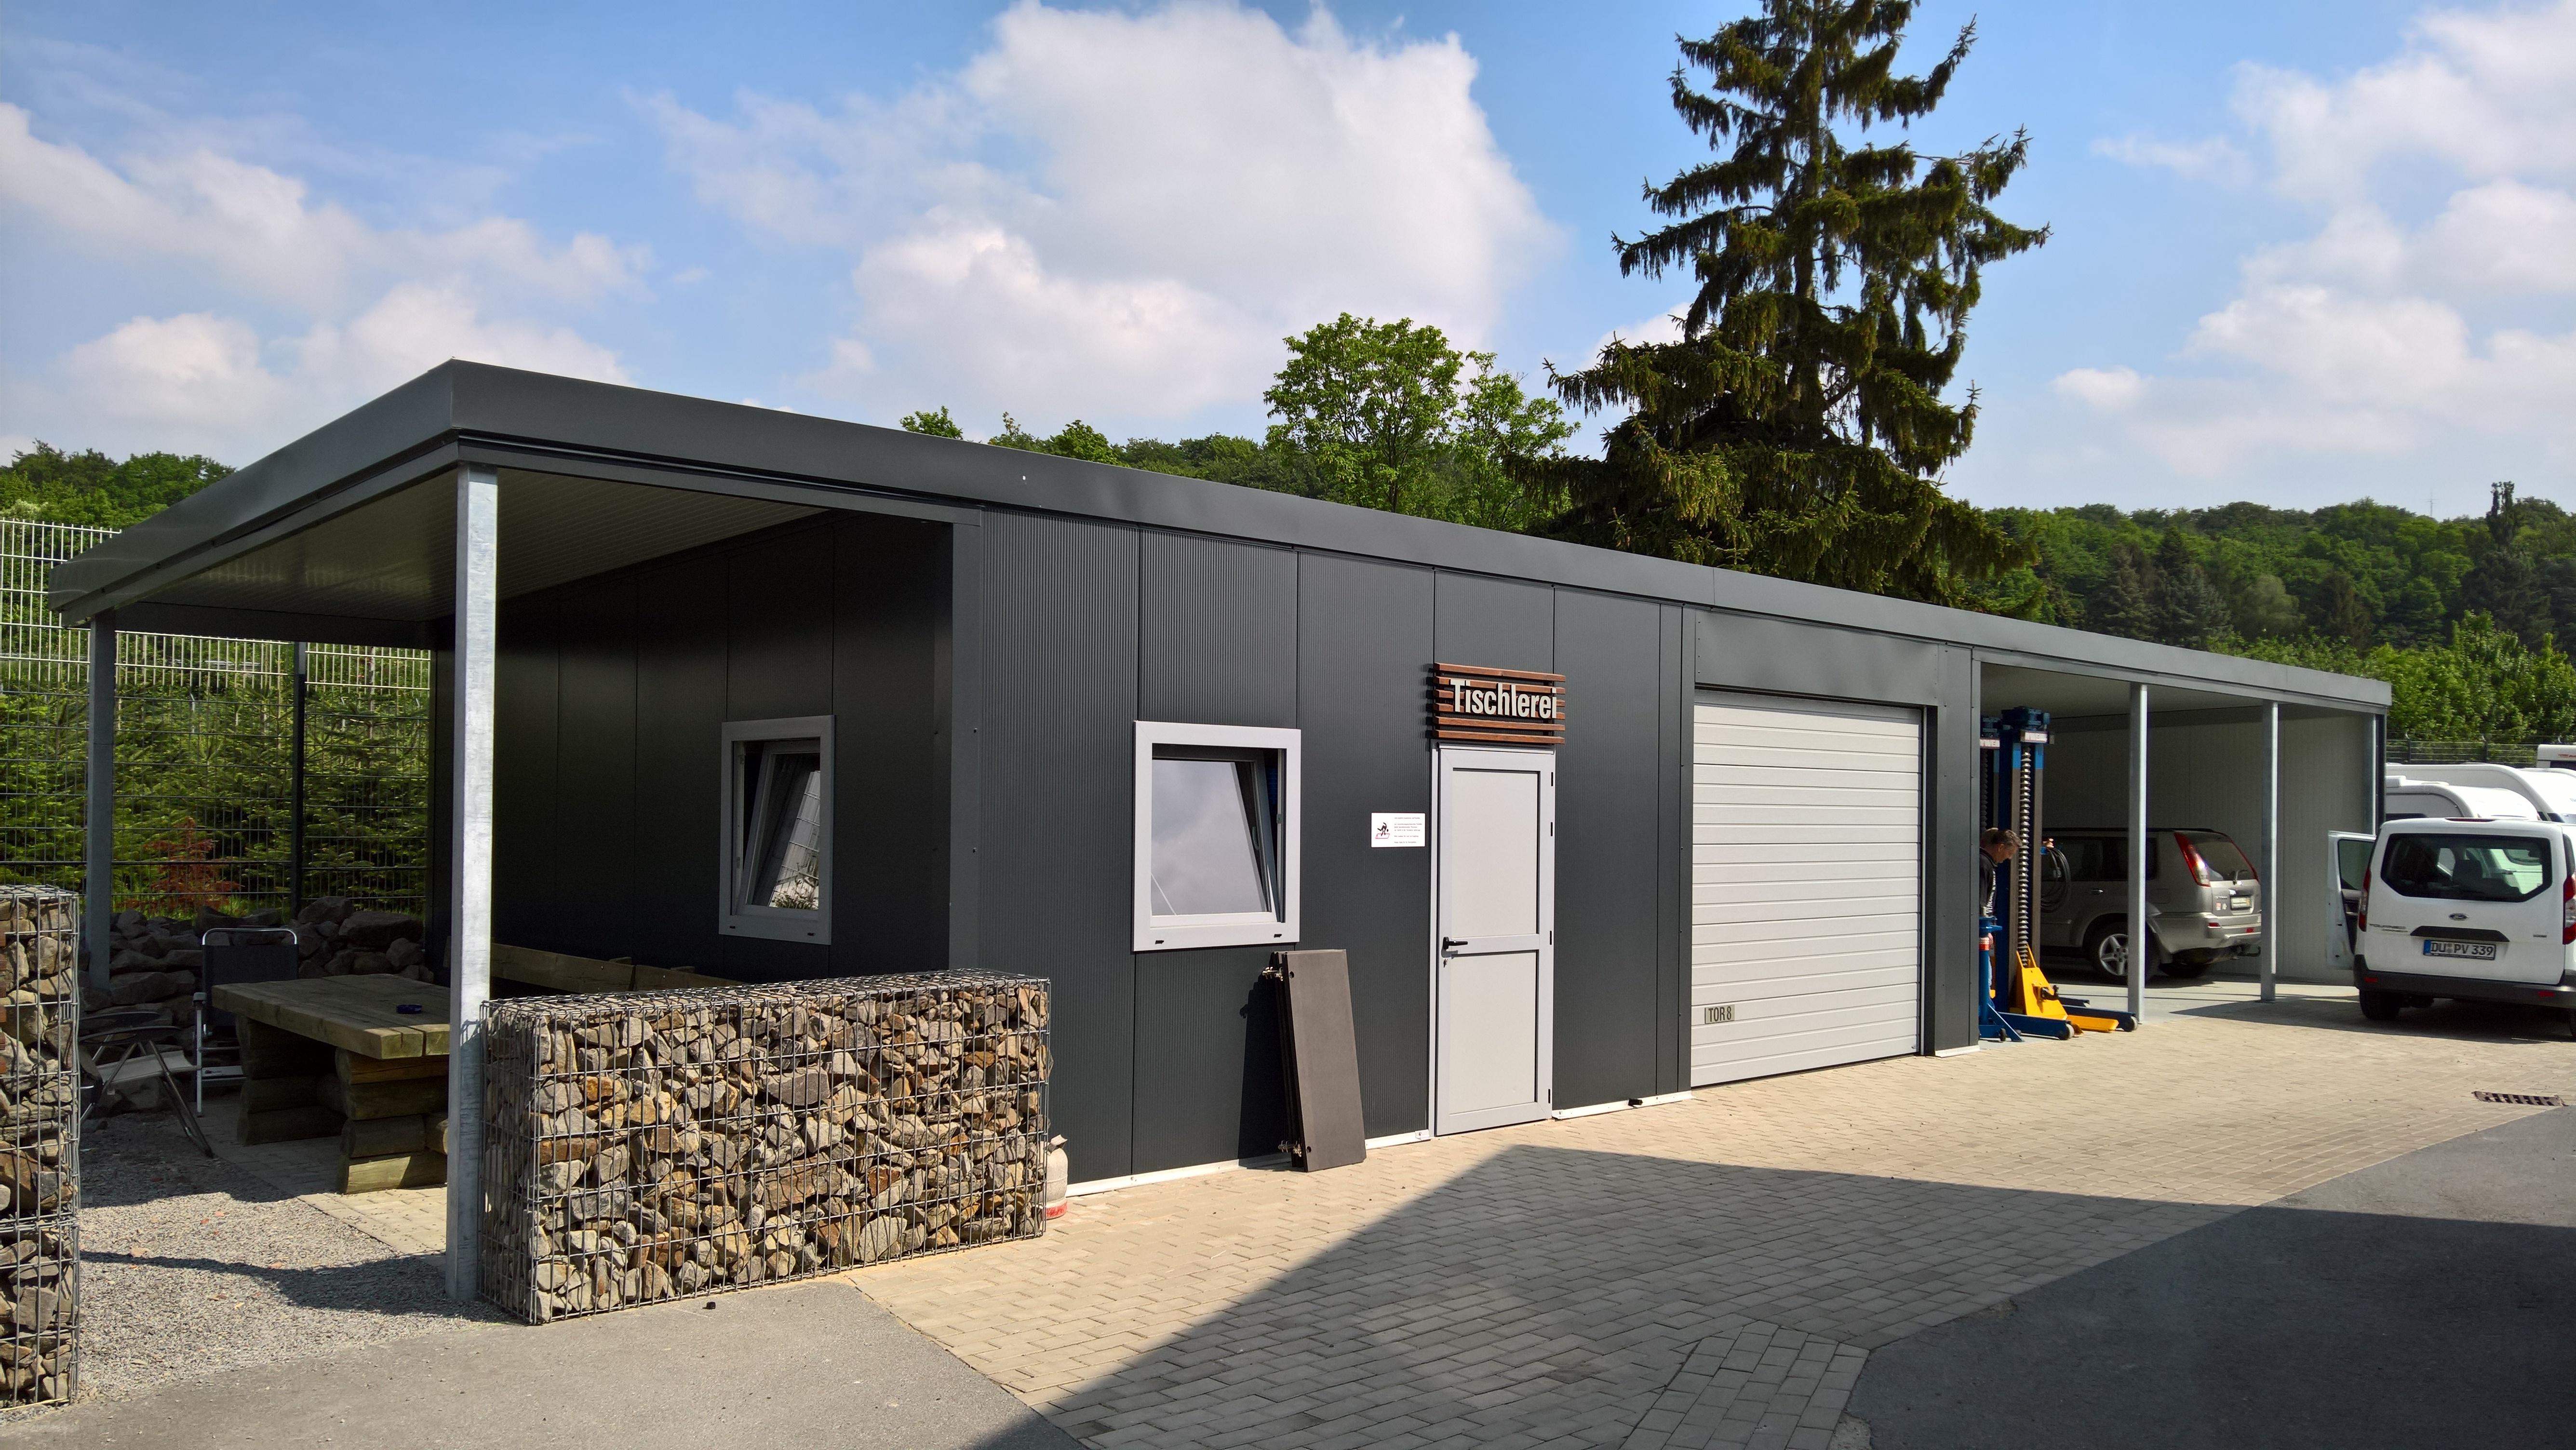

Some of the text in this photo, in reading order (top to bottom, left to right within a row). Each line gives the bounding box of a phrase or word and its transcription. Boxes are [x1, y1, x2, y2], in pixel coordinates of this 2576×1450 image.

[1450, 679, 1556, 719] Tischlerei
[2431, 942, 2494, 956] DU PV 339
[1708, 1006, 1731, 1022] TOR 8
